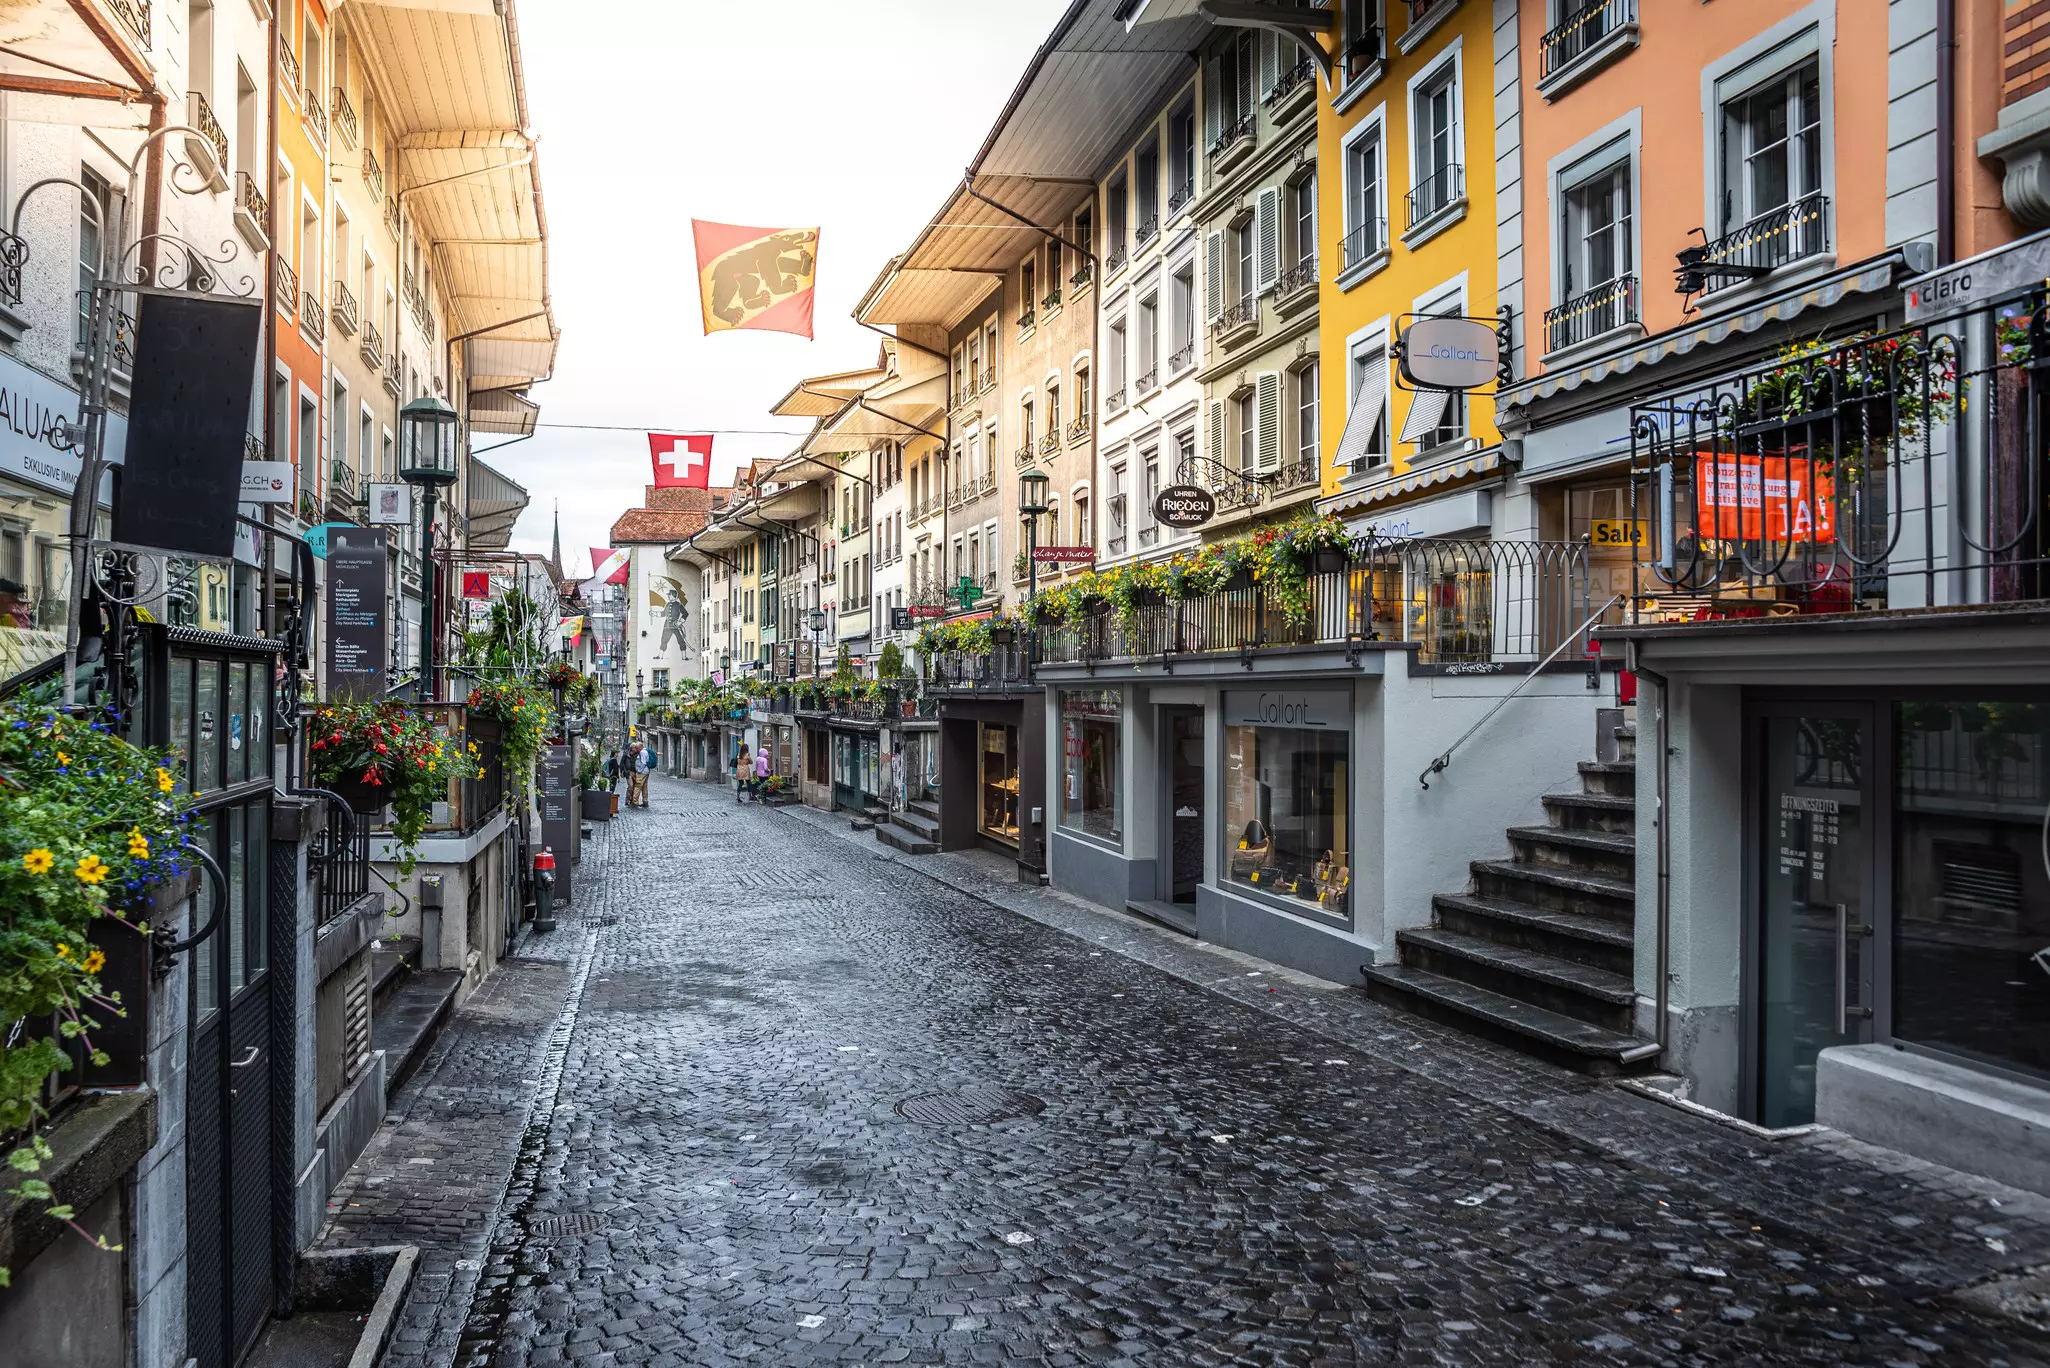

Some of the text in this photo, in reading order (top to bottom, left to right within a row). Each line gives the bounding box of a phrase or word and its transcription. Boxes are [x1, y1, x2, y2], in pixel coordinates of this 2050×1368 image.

[1923, 274, 1972, 303] claro
[1430, 344, 1479, 361] Gallant
[24, 456, 60, 481] EXKLUSIVE
[1707, 465, 1756, 478] Knzrn-
[1162, 498, 1209, 512] FRIEDEN
[1779, 495, 1830, 537] JA!
[1597, 523, 1641, 543] Sale
[1259, 693, 1308, 724] Gallant
[1781, 792, 1839, 813] ÖFFNUNGSZEITEN
